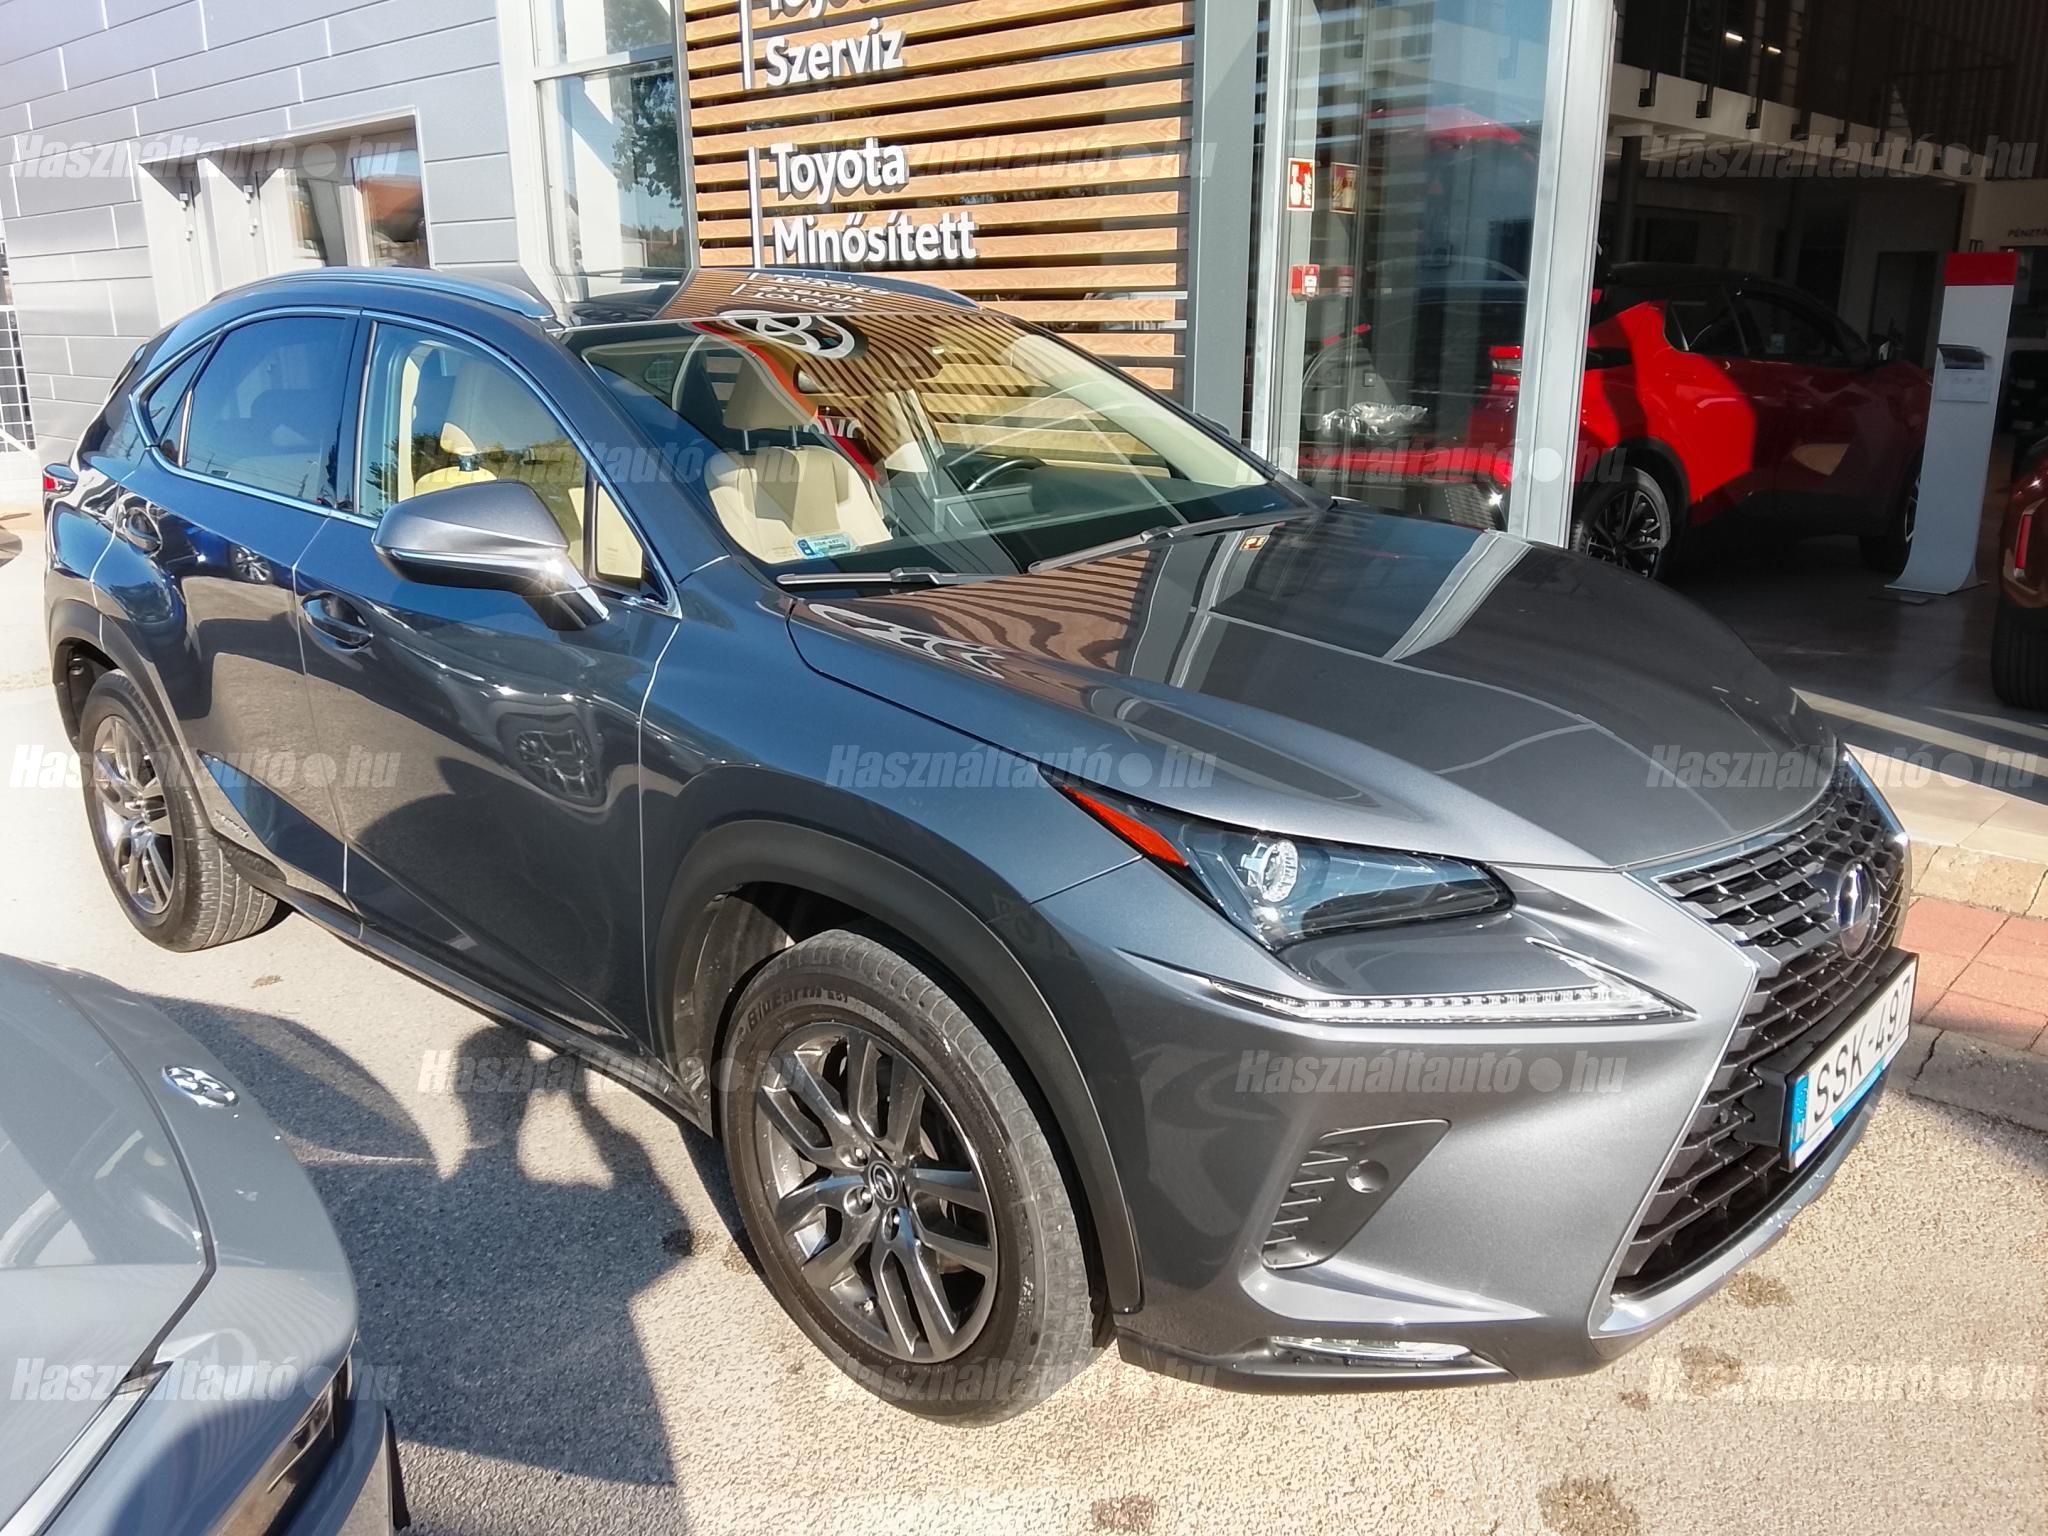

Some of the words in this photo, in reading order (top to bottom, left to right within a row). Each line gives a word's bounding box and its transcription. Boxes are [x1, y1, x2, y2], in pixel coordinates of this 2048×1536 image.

[766, 17, 904, 86] Szerviz
[770, 136, 908, 204] Toyota
[773, 211, 978, 265] Minősített
